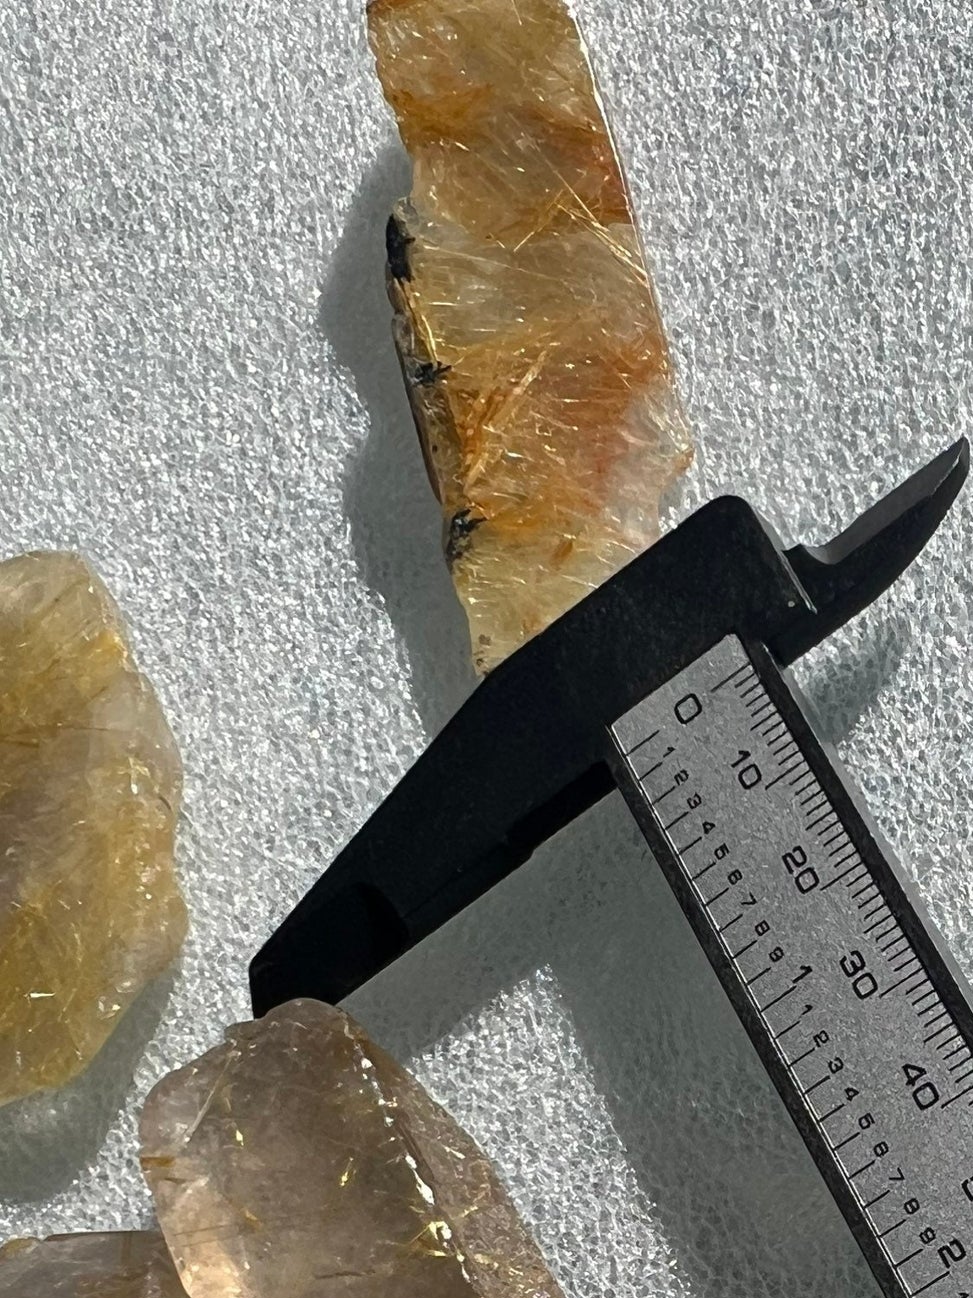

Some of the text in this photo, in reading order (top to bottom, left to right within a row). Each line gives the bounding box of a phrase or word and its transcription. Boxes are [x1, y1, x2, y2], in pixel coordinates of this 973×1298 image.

[662, 746, 676, 759] 1
[674, 770, 688, 785] 2
[687, 793, 702, 809] 3
[703, 822, 715, 834] 4
[714, 843, 729, 860] 5
[674, 693, 702, 724] 0
[731, 750, 762, 789] 10
[782, 846, 819, 894] 20
[840, 950, 878, 1000] 30
[902, 1064, 939, 1110] 40
[741, 893, 757, 905] 7
[755, 920, 770, 936] 8
[793, 966, 812, 983] 1
[801, 1004, 814, 1016] 1
[813, 1031, 829, 1048] 2
[828, 1057, 843, 1074] 3
[845, 1088, 859, 1101] 4
[859, 1113, 875, 1129] 5
[889, 1167, 905, 1181] 7
[904, 1198, 920, 1214] 8
[938, 1239, 966, 1268] 2
